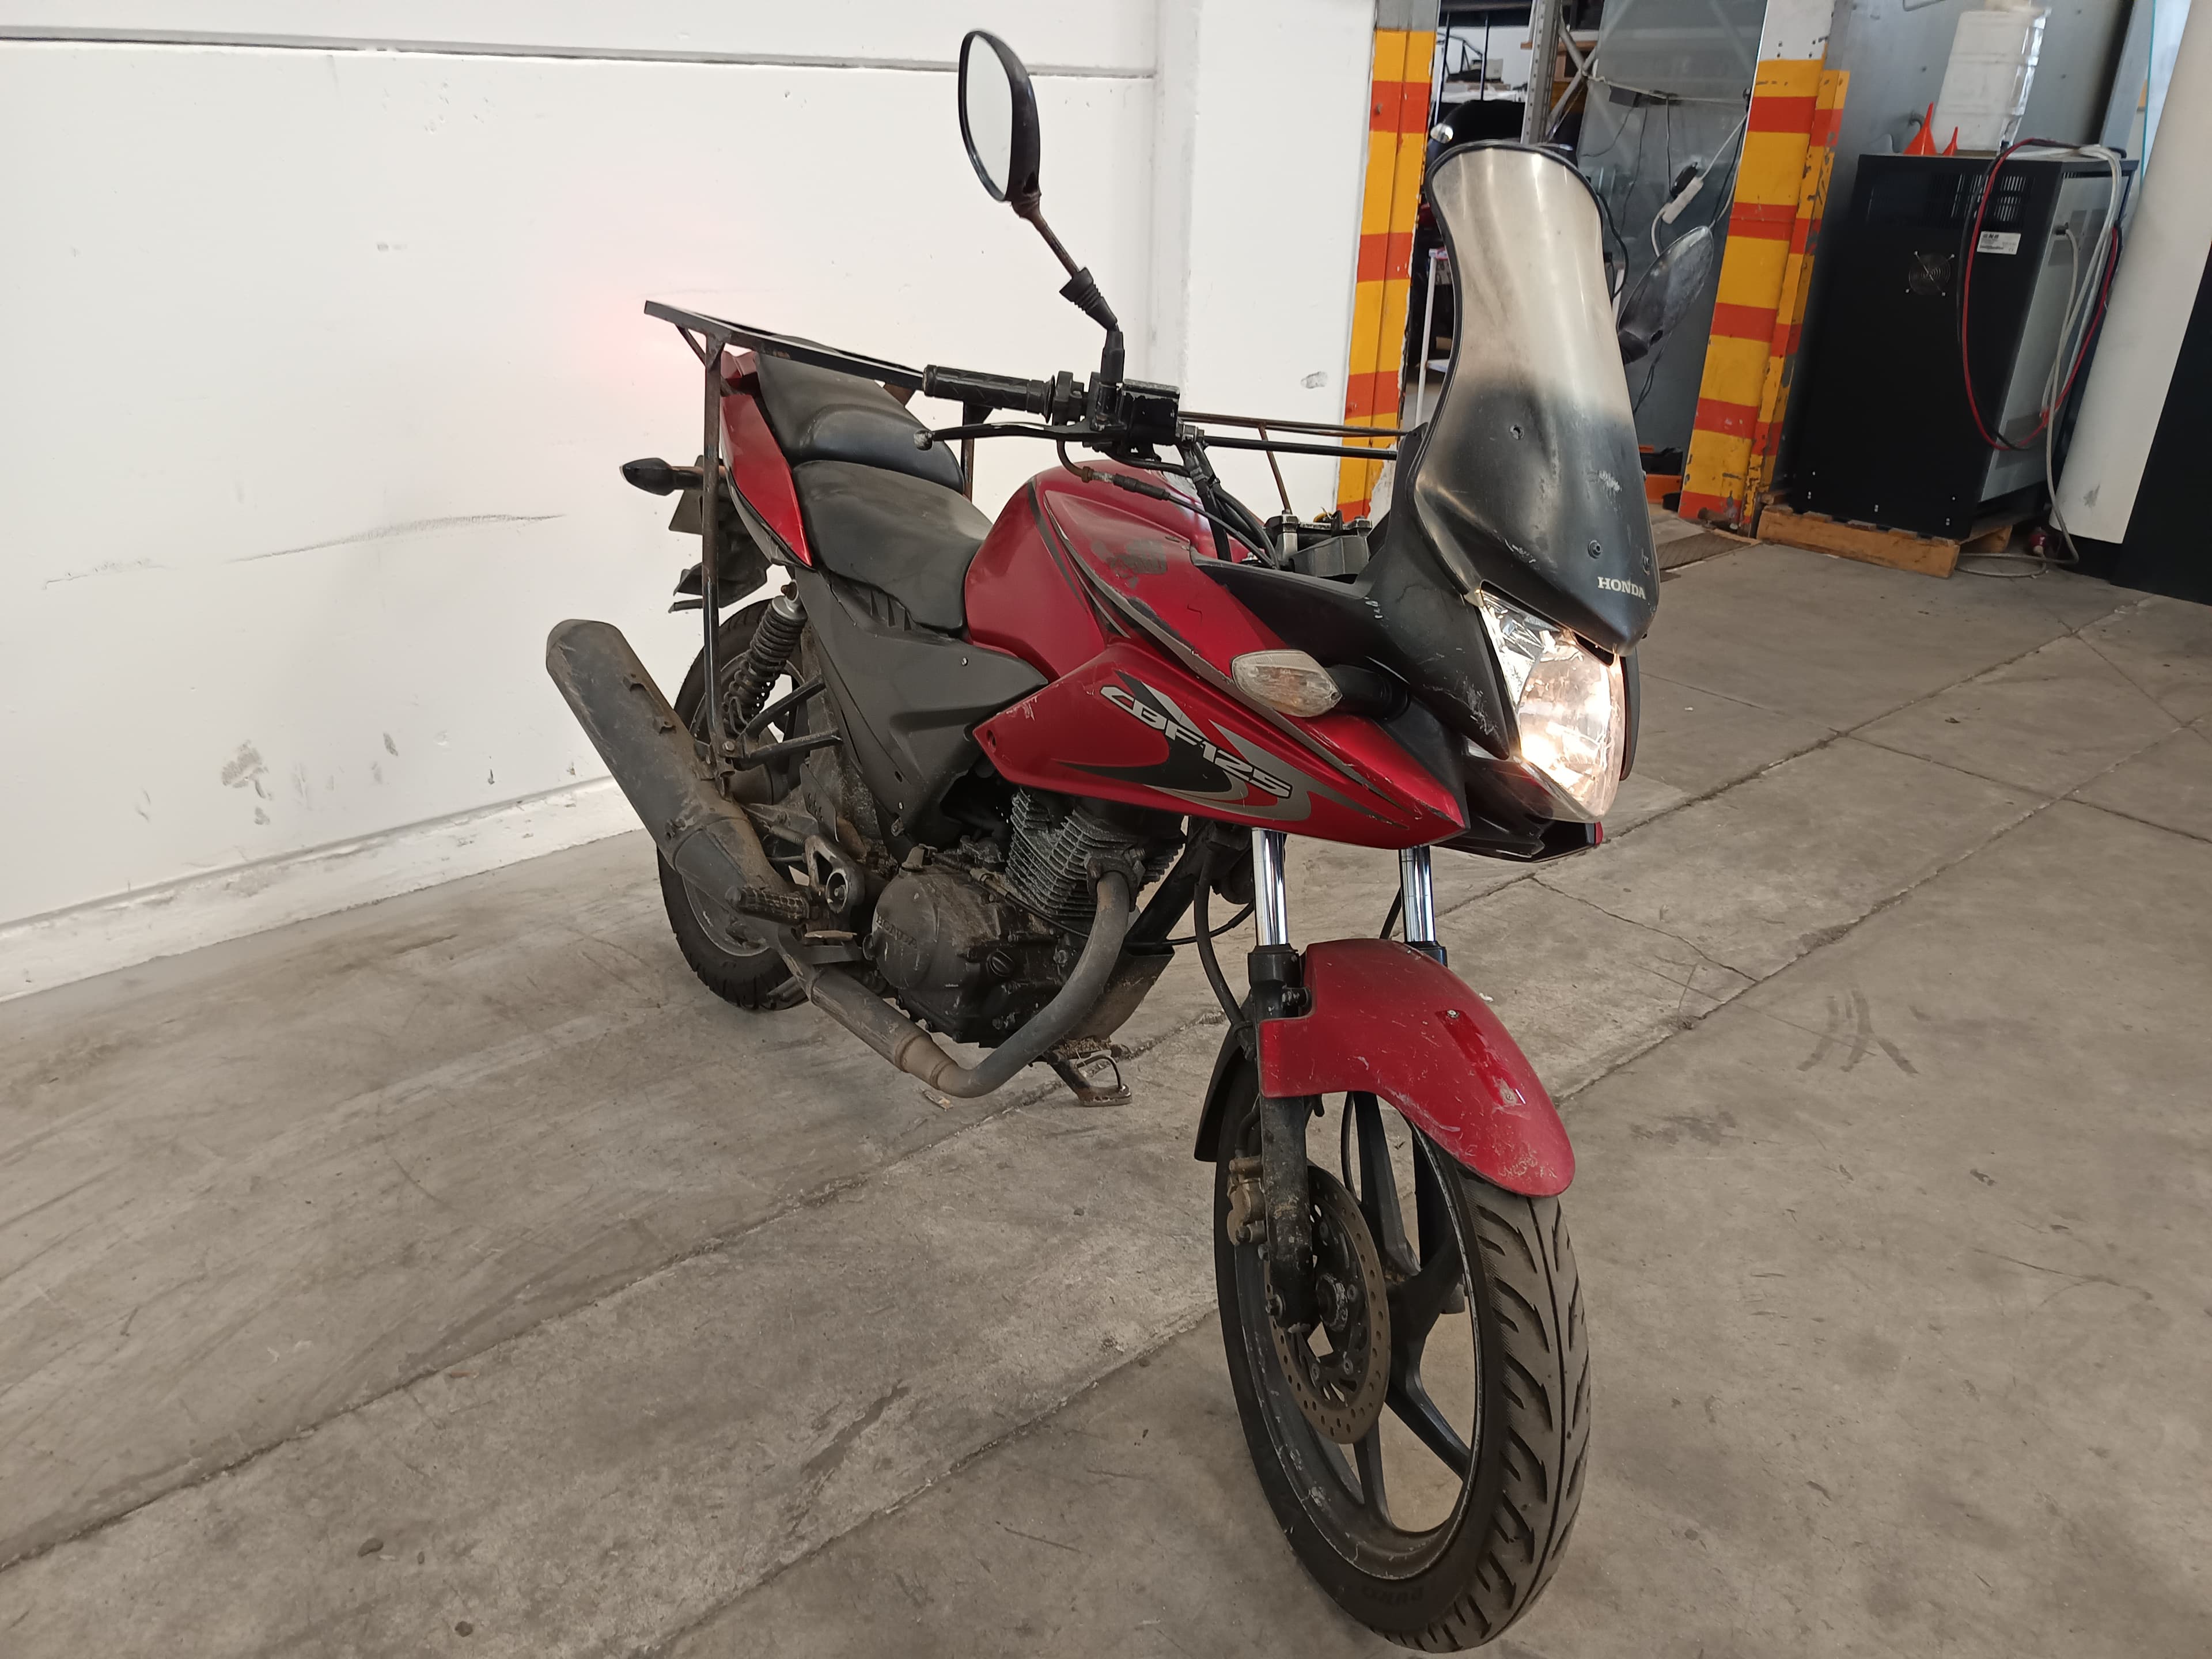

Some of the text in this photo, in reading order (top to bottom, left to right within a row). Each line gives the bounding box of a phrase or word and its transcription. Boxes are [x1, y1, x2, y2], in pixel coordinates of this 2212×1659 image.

[1597, 577, 1646, 600] HONDA
[1100, 685, 1293, 798] CBF125
[876, 915, 917, 949] HONDA
